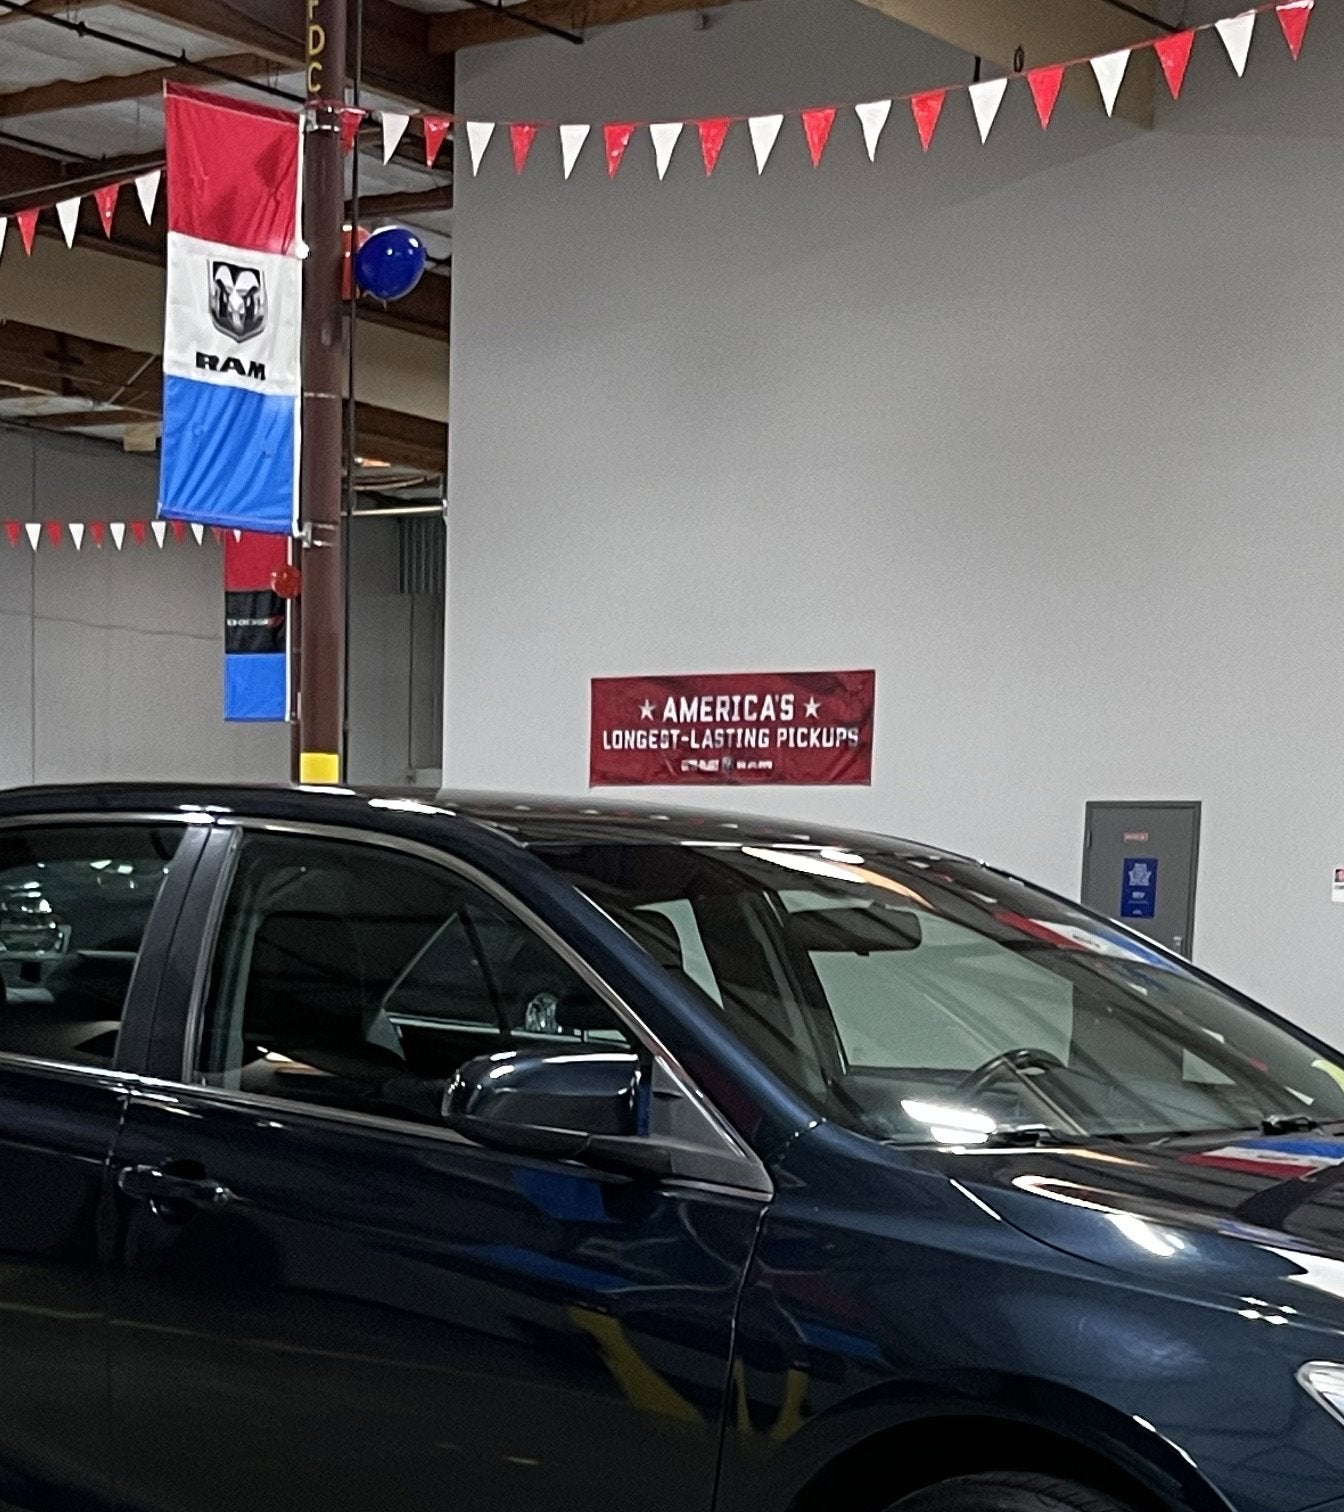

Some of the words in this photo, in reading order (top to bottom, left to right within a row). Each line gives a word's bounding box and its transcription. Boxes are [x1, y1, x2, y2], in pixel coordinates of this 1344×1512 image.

[195, 351, 267, 381] RAM
[662, 693, 795, 723] AMERICA'S
[602, 728, 769, 751] LONGEST-LASTING
[776, 726, 859, 749] PICKUPS
